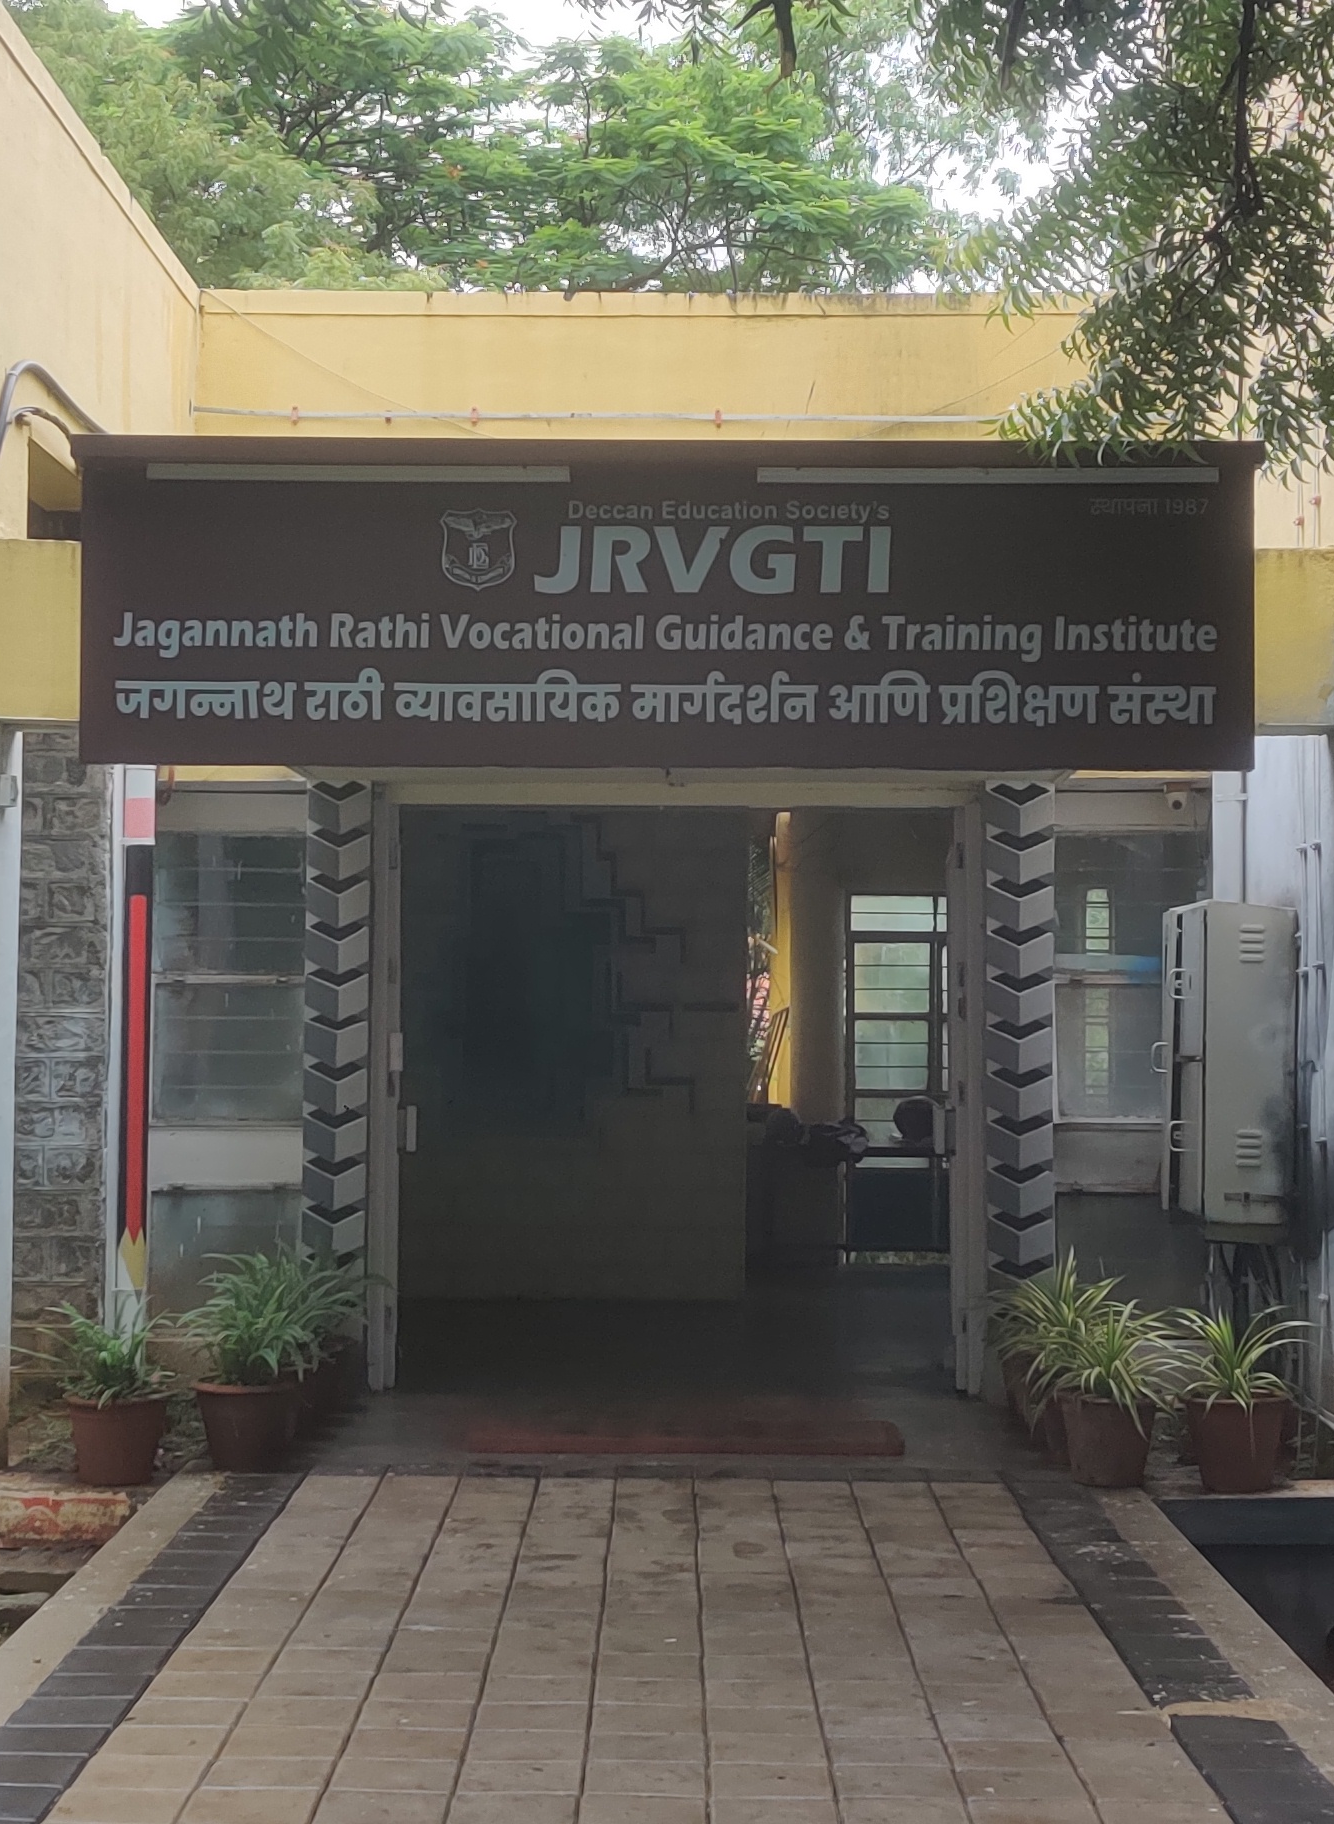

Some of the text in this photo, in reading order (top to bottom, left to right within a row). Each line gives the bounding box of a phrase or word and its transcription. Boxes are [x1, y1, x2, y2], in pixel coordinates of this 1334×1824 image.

[568, 501, 890, 522] Deccan Education Society's
[1165, 498, 1209, 515] 1987
[533, 525, 892, 595] JRVGTI
[114, 611, 1217, 662] Jagannath Rathi Vocational Guidance & Training Institute
[114, 668, 1216, 727] जगन्नाथ राठी व्यावसायिक मार्गदर्शन आणि प्रशिक्षण संस्था
